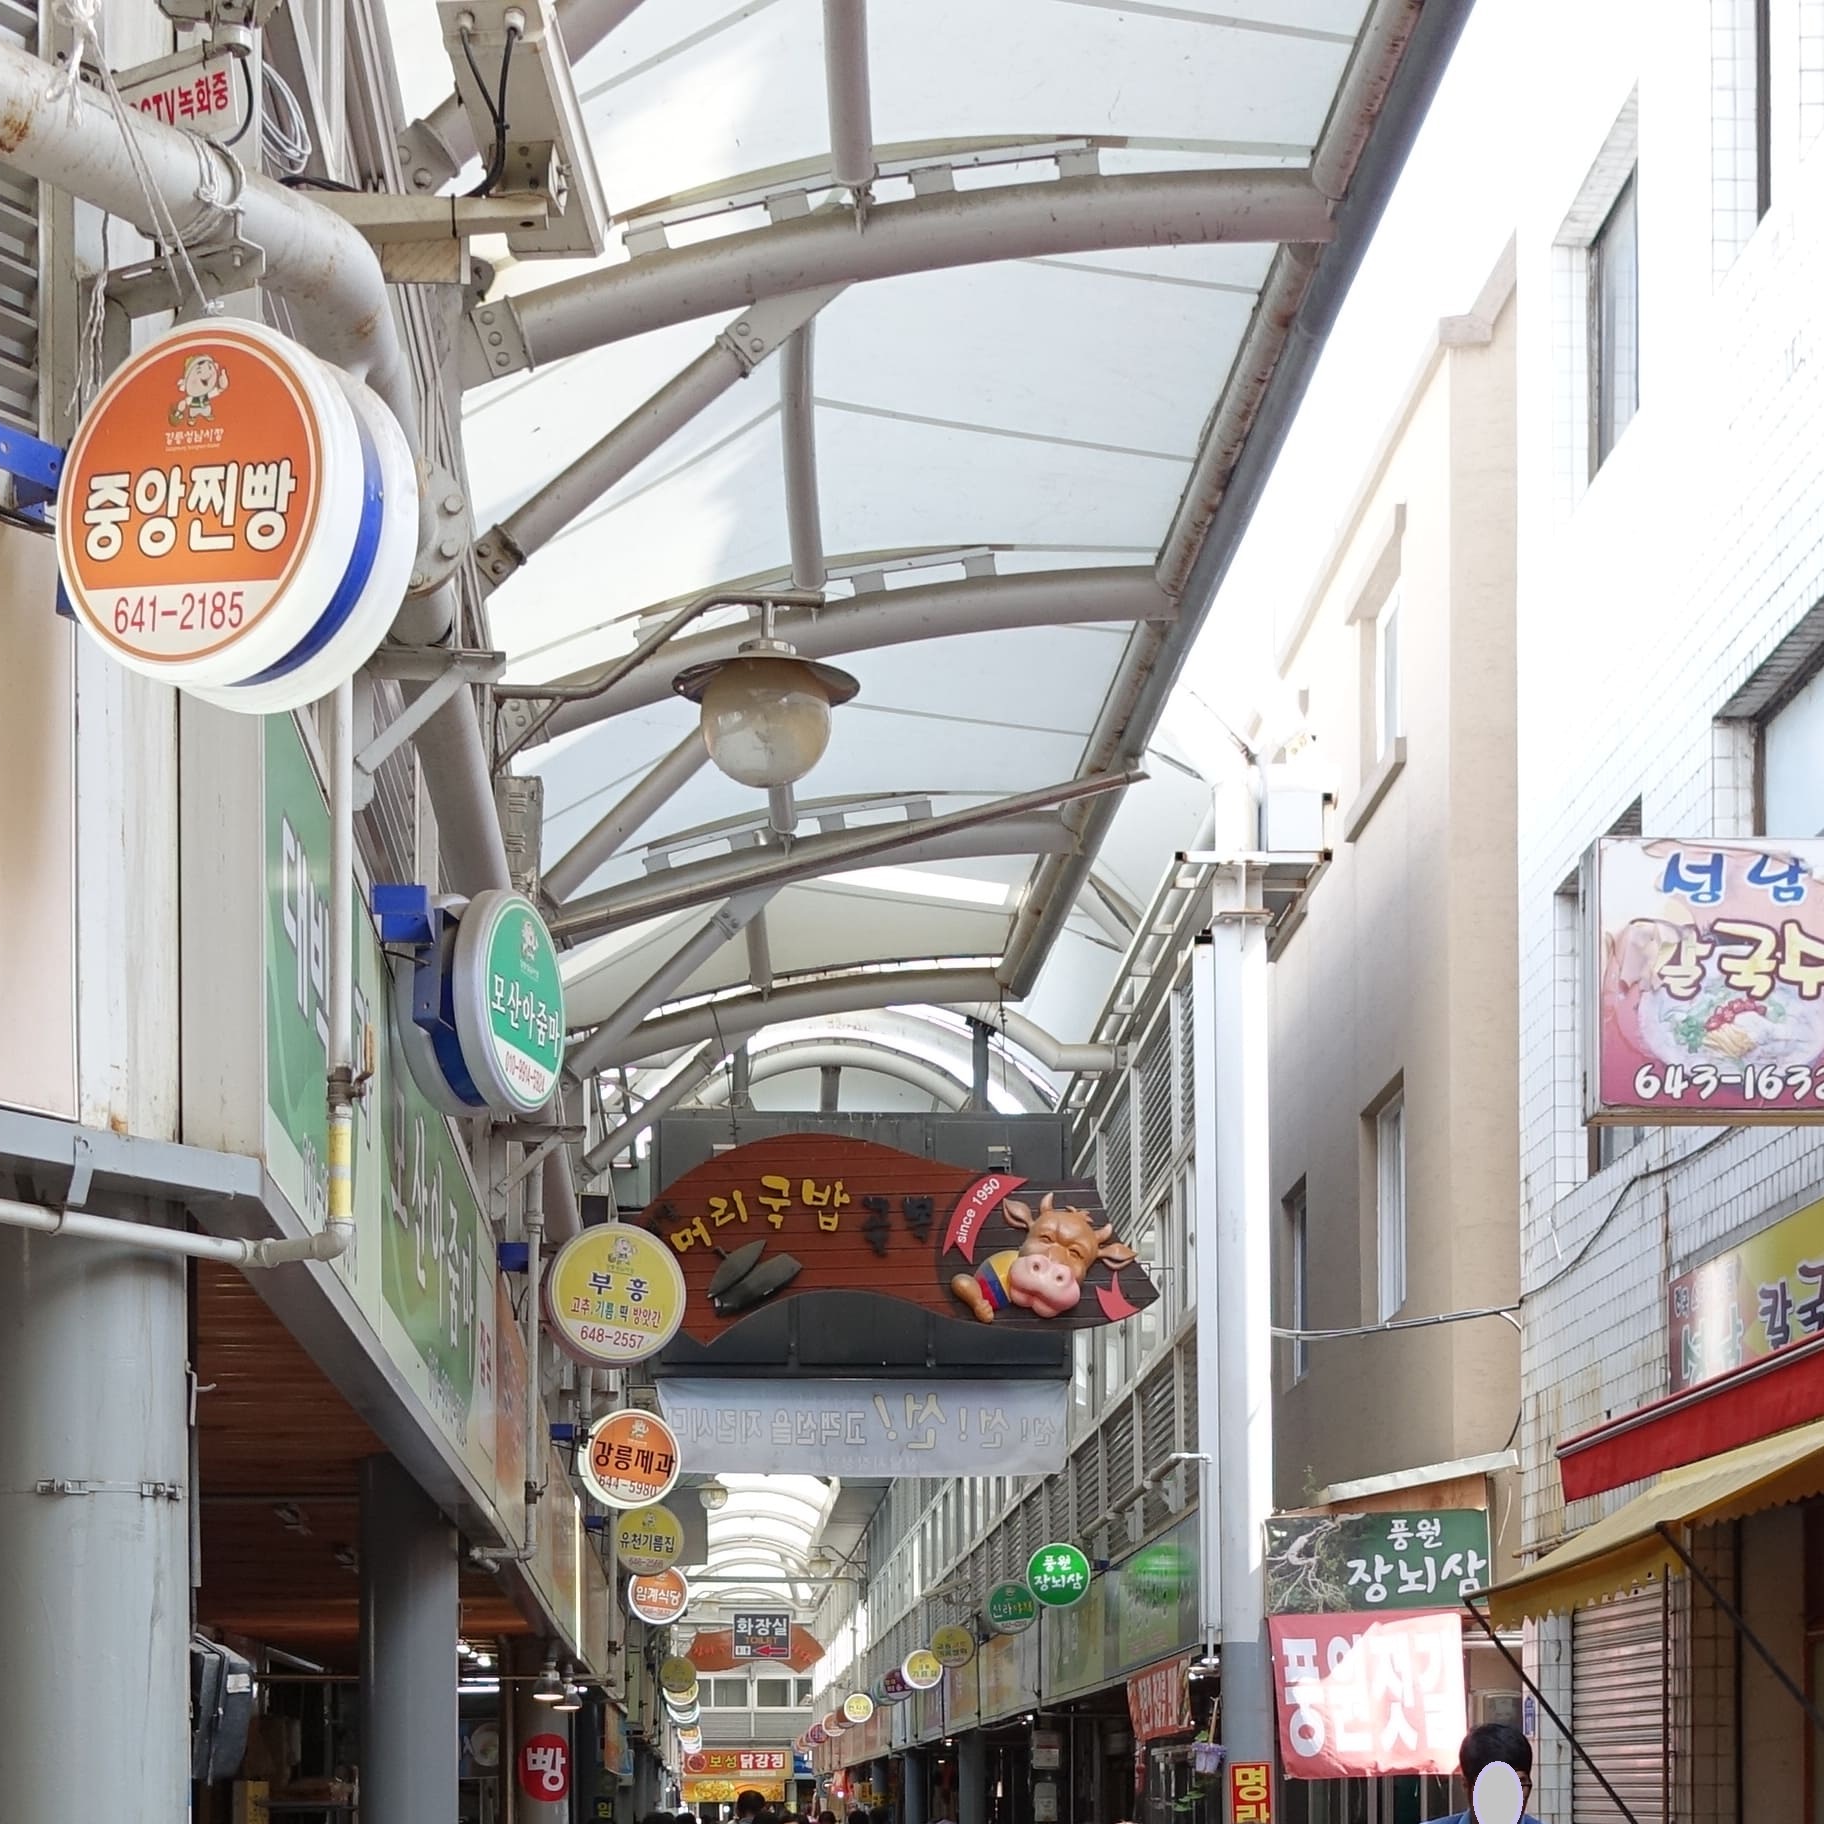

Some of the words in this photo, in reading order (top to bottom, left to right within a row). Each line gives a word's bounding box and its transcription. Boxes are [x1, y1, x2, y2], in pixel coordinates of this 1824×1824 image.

[82, 456, 298, 562] 중앙찐빵
[113, 591, 245, 636] 641-2185
[1662, 852, 1809, 906] 성남
[491, 974, 561, 1059] 모산아줌마
[954, 1207, 979, 1245] since
[972, 1176, 1001, 1209] 1950
[588, 1271, 649, 1302] 부흥
[632, 1306, 662, 1329] 방앗간
[580, 1325, 645, 1350] 648-2557
[595, 1440, 676, 1480] 강릉제과
[619, 1531, 676, 1554] 유천기름집
[1386, 1517, 1443, 1551] 풍원
[1042, 1554, 1072, 1572] 풍원
[1346, 1549, 1488, 1604] 장뇌삼
[635, 1584, 682, 1606] 임계식당
[1033, 1571, 1084, 1592] 장뇌삼
[736, 1617, 788, 1637] 화장실
[746, 1636, 778, 1645] TOILET
[526, 1746, 567, 1792] 빵
[709, 1754, 737, 1769] 보성
[739, 1752, 786, 1769] 닭강정
